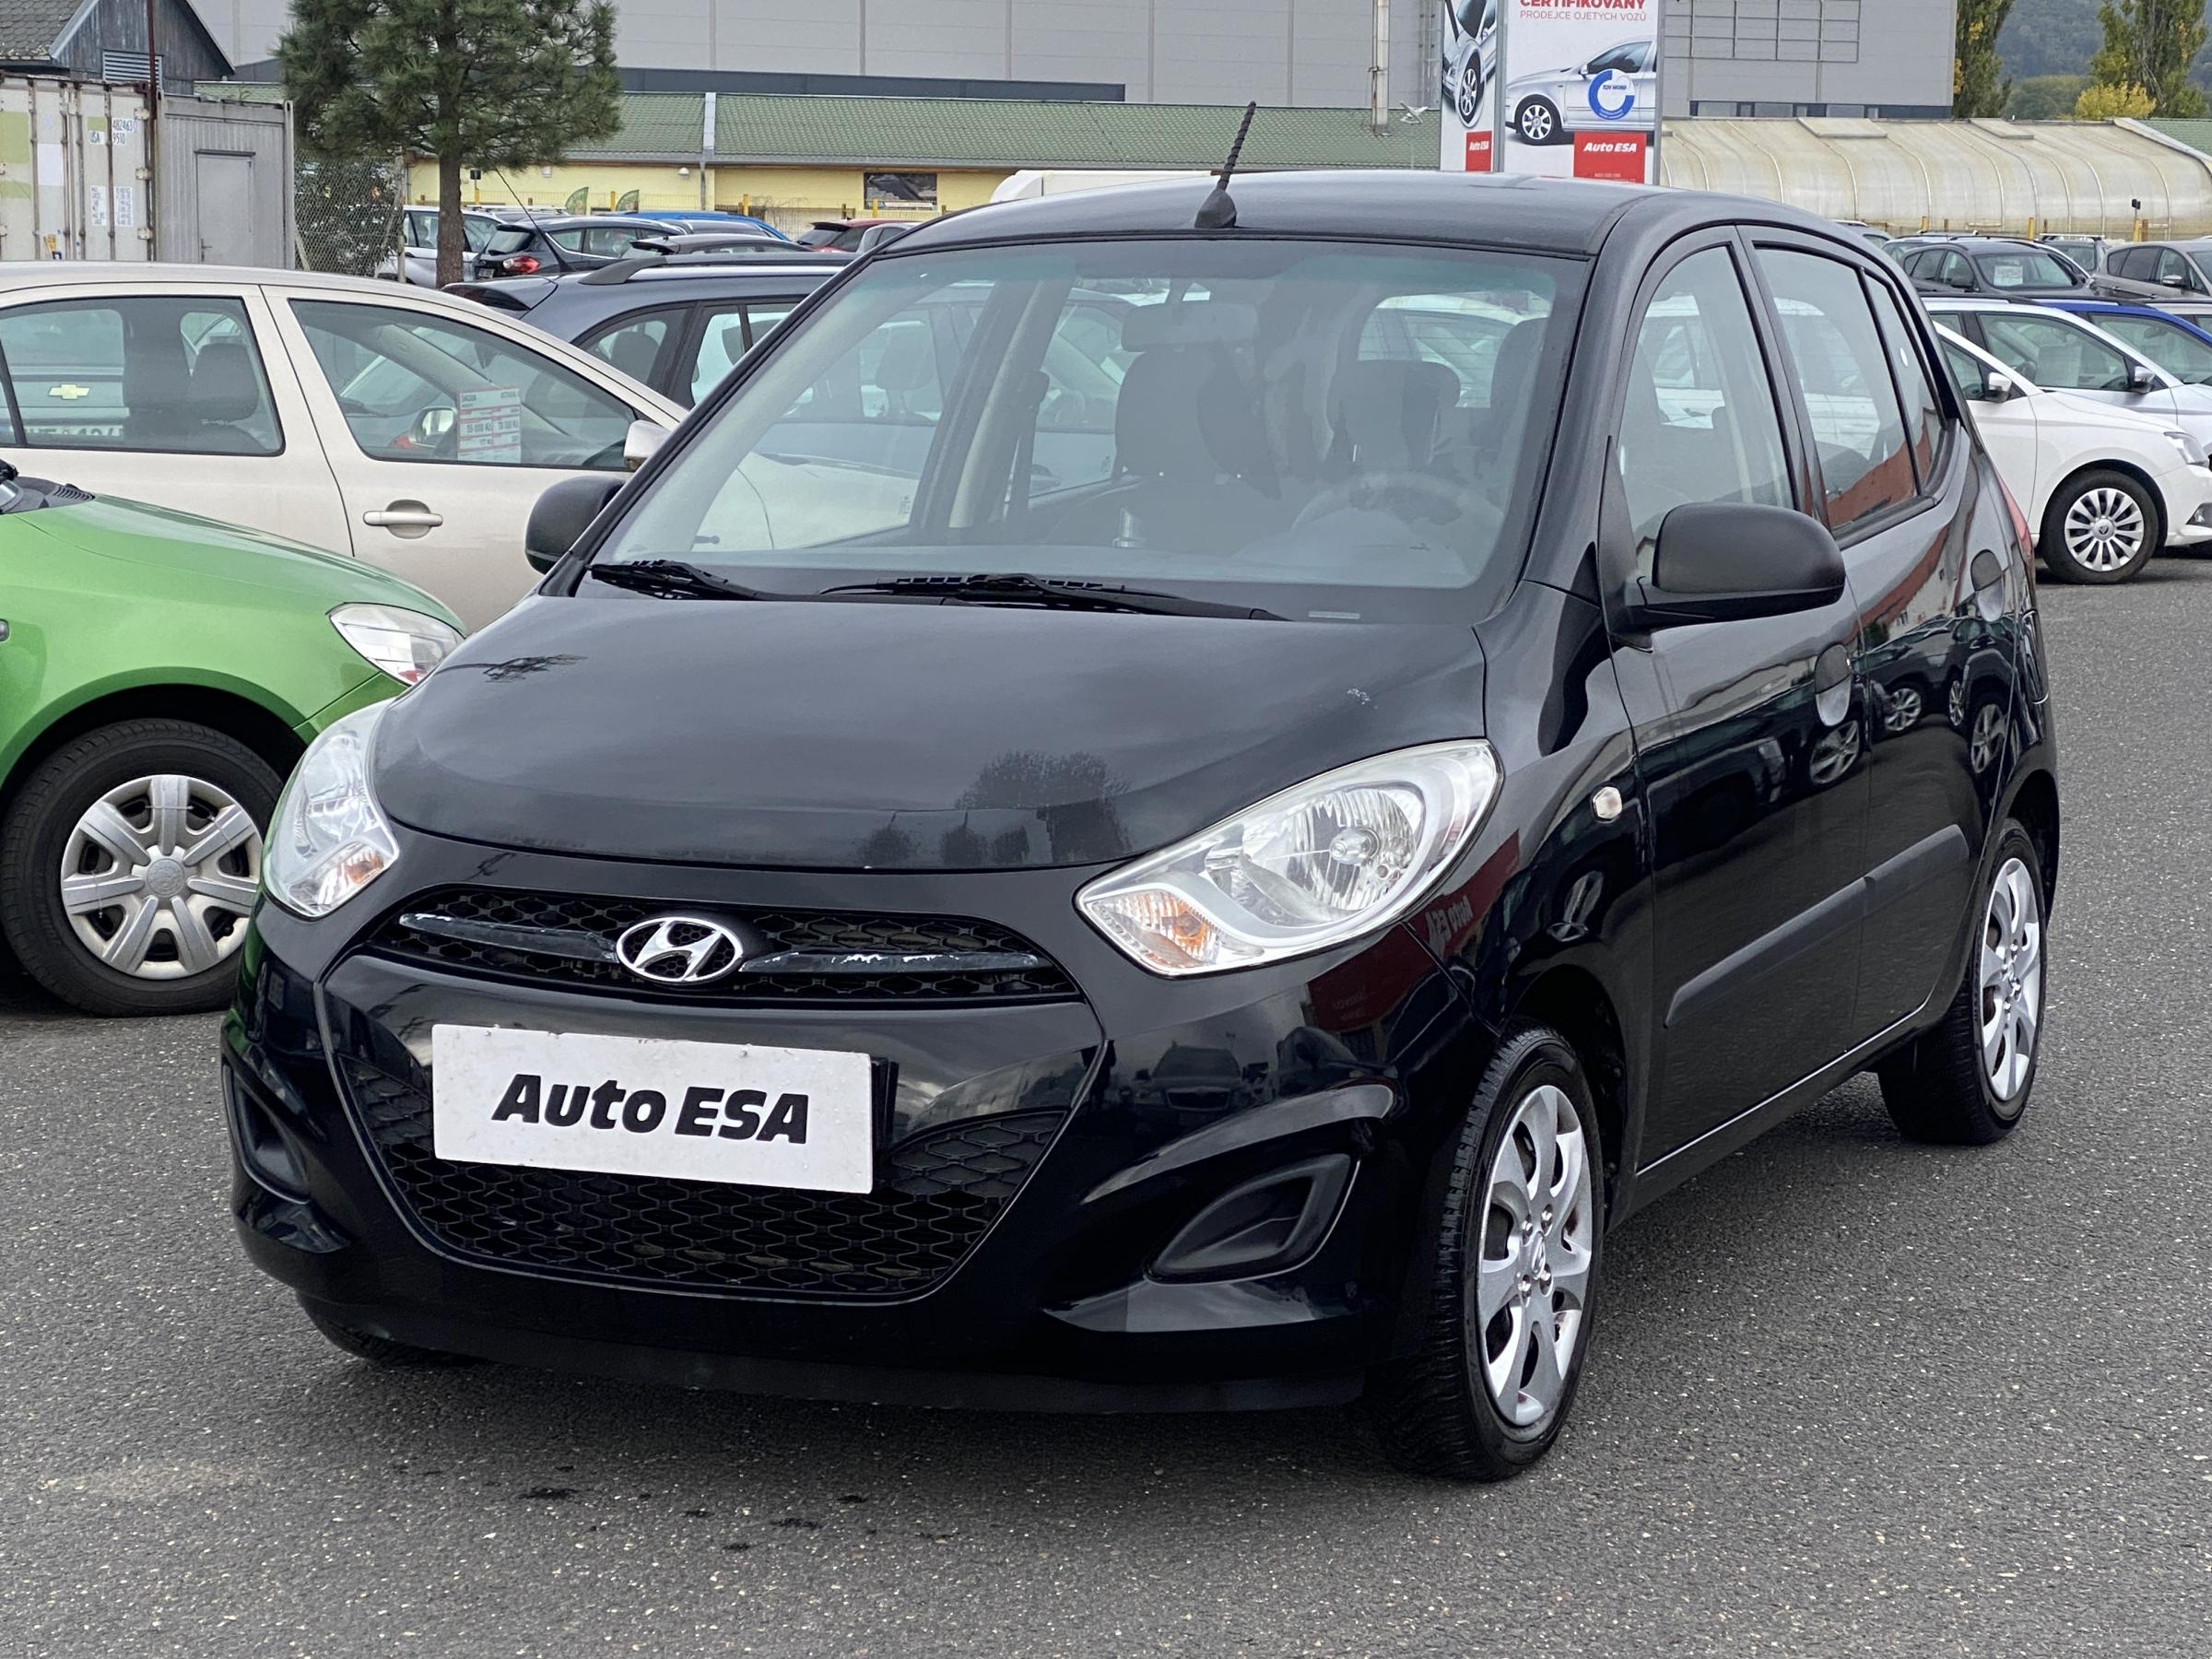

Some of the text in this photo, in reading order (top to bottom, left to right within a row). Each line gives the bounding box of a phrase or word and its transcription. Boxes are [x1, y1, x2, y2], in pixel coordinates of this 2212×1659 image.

[1520, 10, 1571, 19] PRODEJCE
[1583, 142, 1638, 153] Auto ESA
[490, 1074, 809, 1145] Auto ESA
